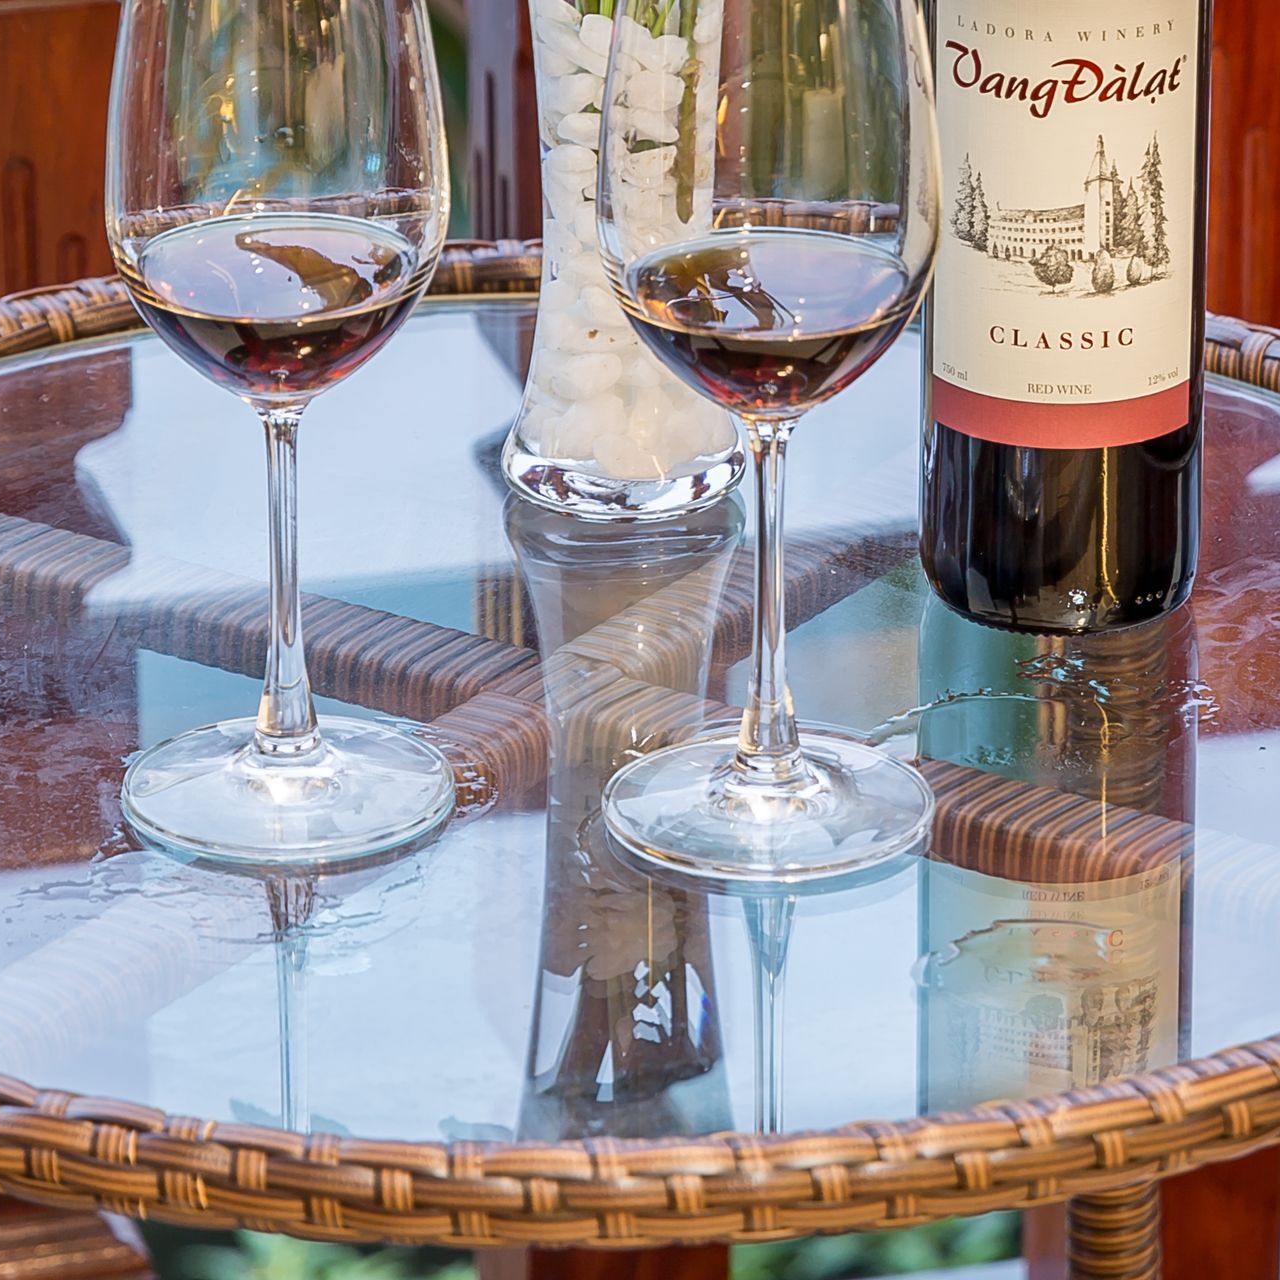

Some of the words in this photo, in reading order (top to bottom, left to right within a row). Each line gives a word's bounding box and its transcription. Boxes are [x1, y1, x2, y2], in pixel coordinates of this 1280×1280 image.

[957, 15, 1053, 43] LADORA
[1077, 19, 1175, 42] WINERY
[989, 325, 1134, 350] CLASSIC
[941, 361, 956, 377] 750
[957, 370, 968, 381] ml
[1147, 373, 1166, 386] 12%
[1167, 367, 1179, 379] vol
[1027, 382, 1054, 395] RED
[1056, 383, 1092, 395] WINE
